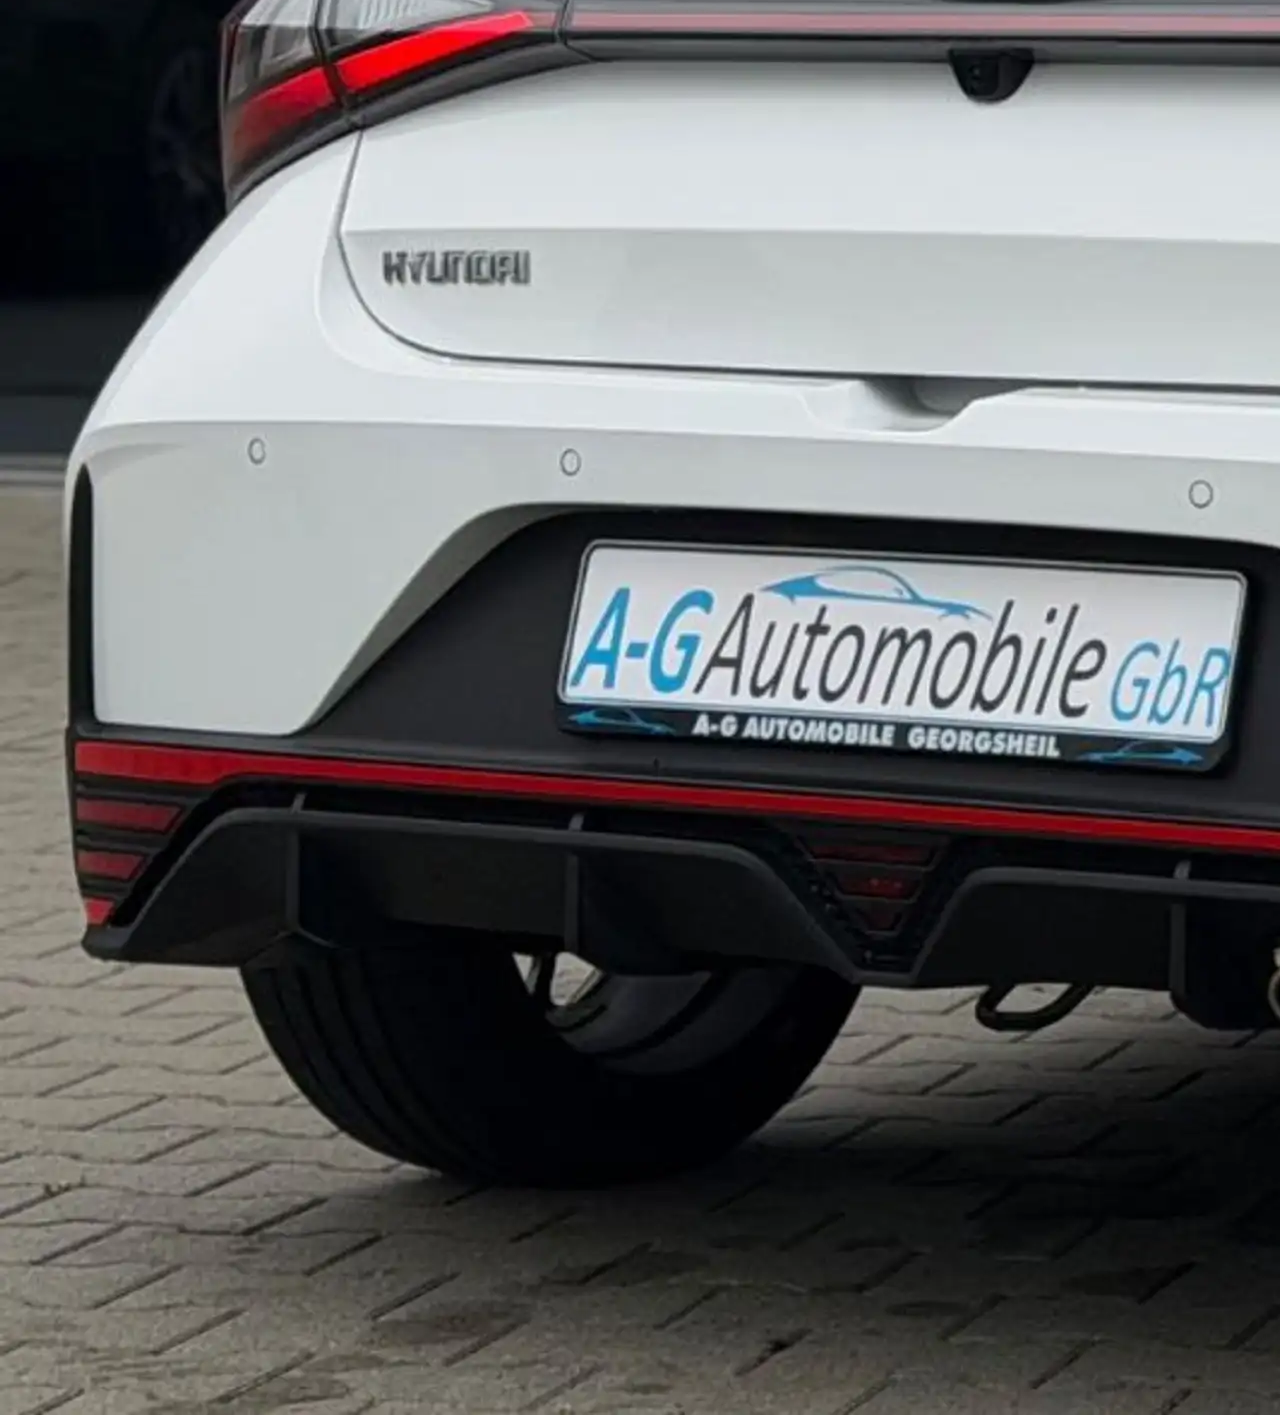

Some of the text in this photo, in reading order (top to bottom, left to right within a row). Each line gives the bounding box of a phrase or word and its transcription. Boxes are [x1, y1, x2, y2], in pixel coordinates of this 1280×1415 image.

[382, 250, 531, 286] HYUNDAI
[568, 586, 1231, 728] A-G Automobile GbR
[692, 713, 1061, 759] A-G AUTOMOBILE GEORGSHEIL
